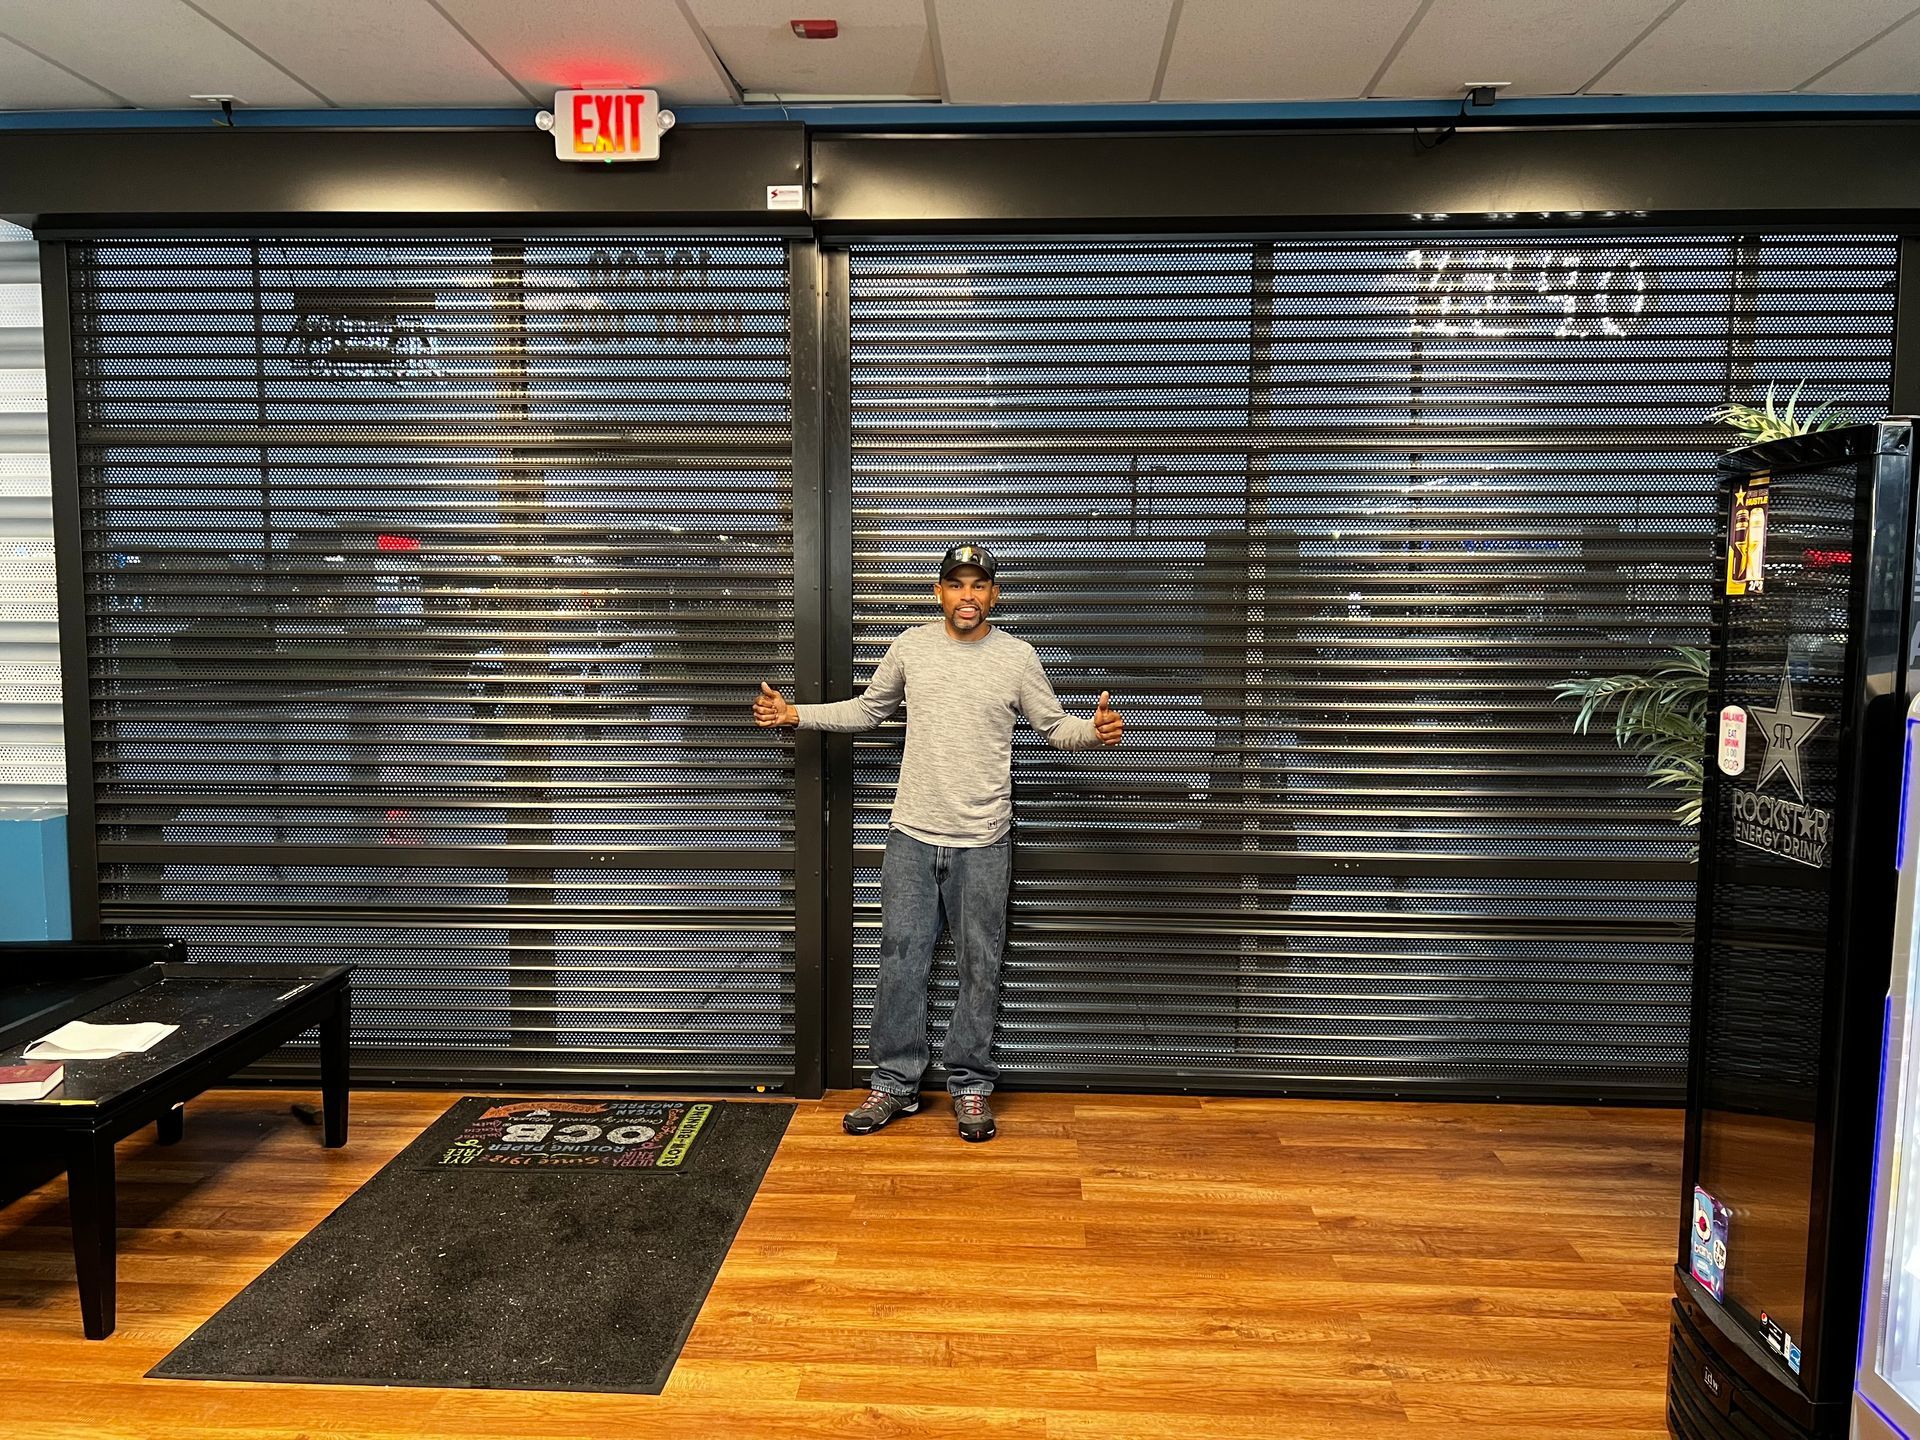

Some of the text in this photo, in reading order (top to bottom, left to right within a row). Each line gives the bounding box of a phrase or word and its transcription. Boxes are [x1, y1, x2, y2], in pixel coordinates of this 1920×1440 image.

[572, 94, 645, 153] EXIT
[1735, 820, 1823, 865] ENERGY DRINK
[615, 1108, 664, 1116] VEGAN
[501, 1123, 657, 1145] OCB
[442, 1148, 485, 1157] FREE
[487, 1143, 626, 1153] ROLLING PAPER
[488, 1155, 533, 1166] 1918
